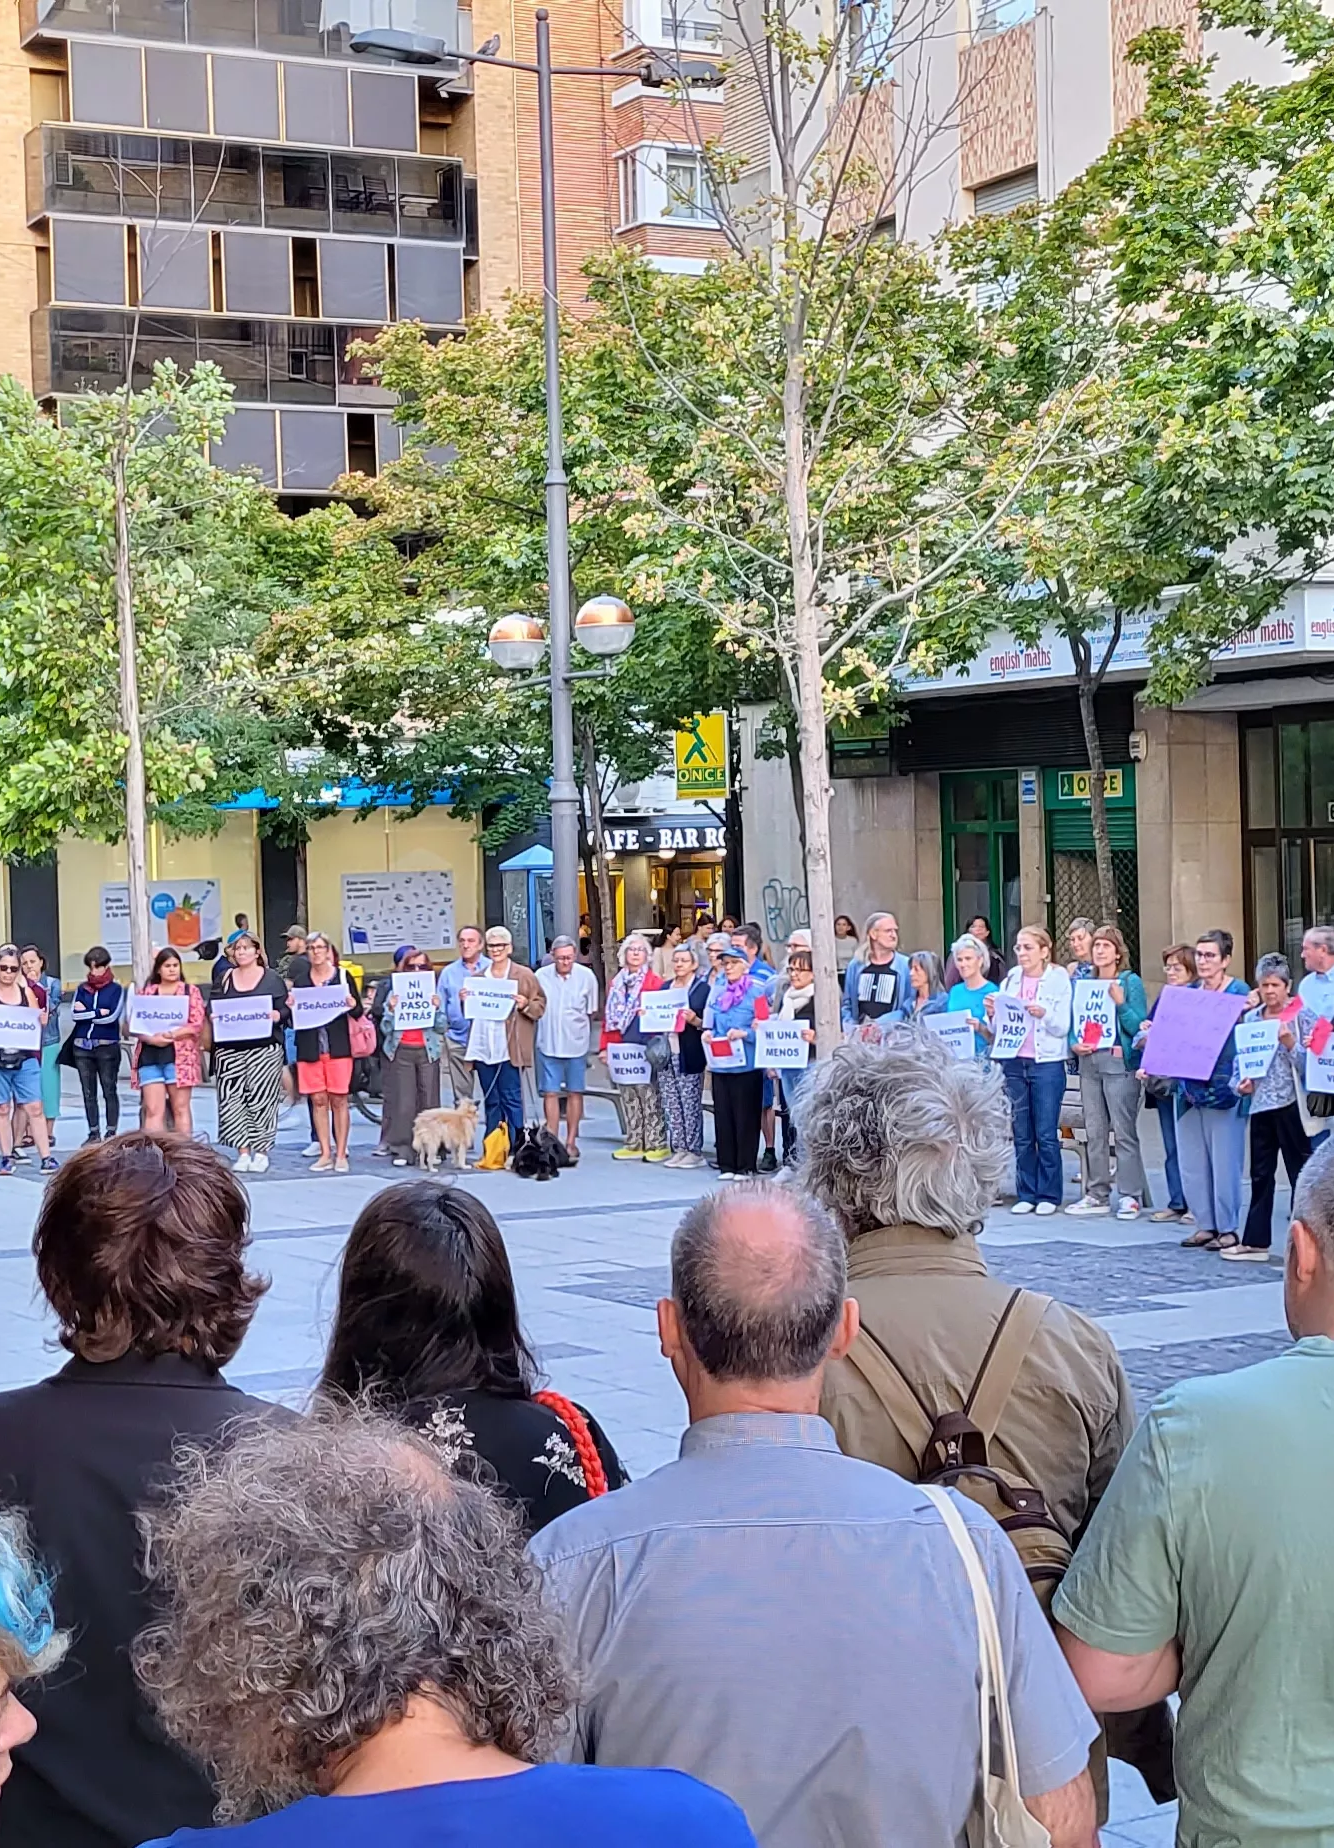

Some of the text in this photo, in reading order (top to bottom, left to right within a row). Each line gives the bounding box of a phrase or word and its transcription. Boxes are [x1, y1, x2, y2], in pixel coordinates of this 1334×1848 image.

[1260, 619, 1294, 643] maths
[989, 646, 1052, 678] english maths
[678, 768, 725, 782] ONCE
[1077, 775, 1118, 792] OE
[658, 827, 699, 849] BAR
[408, 980, 420, 989] NI
[407, 991, 424, 1000] UN
[1090, 989, 1104, 999] NI
[297, 1000, 346, 1011] #SeAcabó
[400, 1001, 430, 1010] PASO
[1084, 1001, 1104, 1012] UN
[135, 1011, 184, 1021] #SeAcabó
[218, 1012, 268, 1024] #SeAcabó
[398, 1011, 432, 1021] ATRÁS
[1008, 1011, 1024, 1024] UN
[1079, 1013, 1109, 1025] PASO
[765, 1031, 799, 1040] NI UNA
[1002, 1024, 1027, 1037] PASO
[1250, 1031, 1265, 1039] NOS
[996, 1036, 1023, 1049] ATRÁS
[611, 1052, 644, 1061] NI UNA
[765, 1047, 800, 1057] MENOS
[1244, 1060, 1265, 1070] VIVAS
[614, 1066, 646, 1076] MENOS
